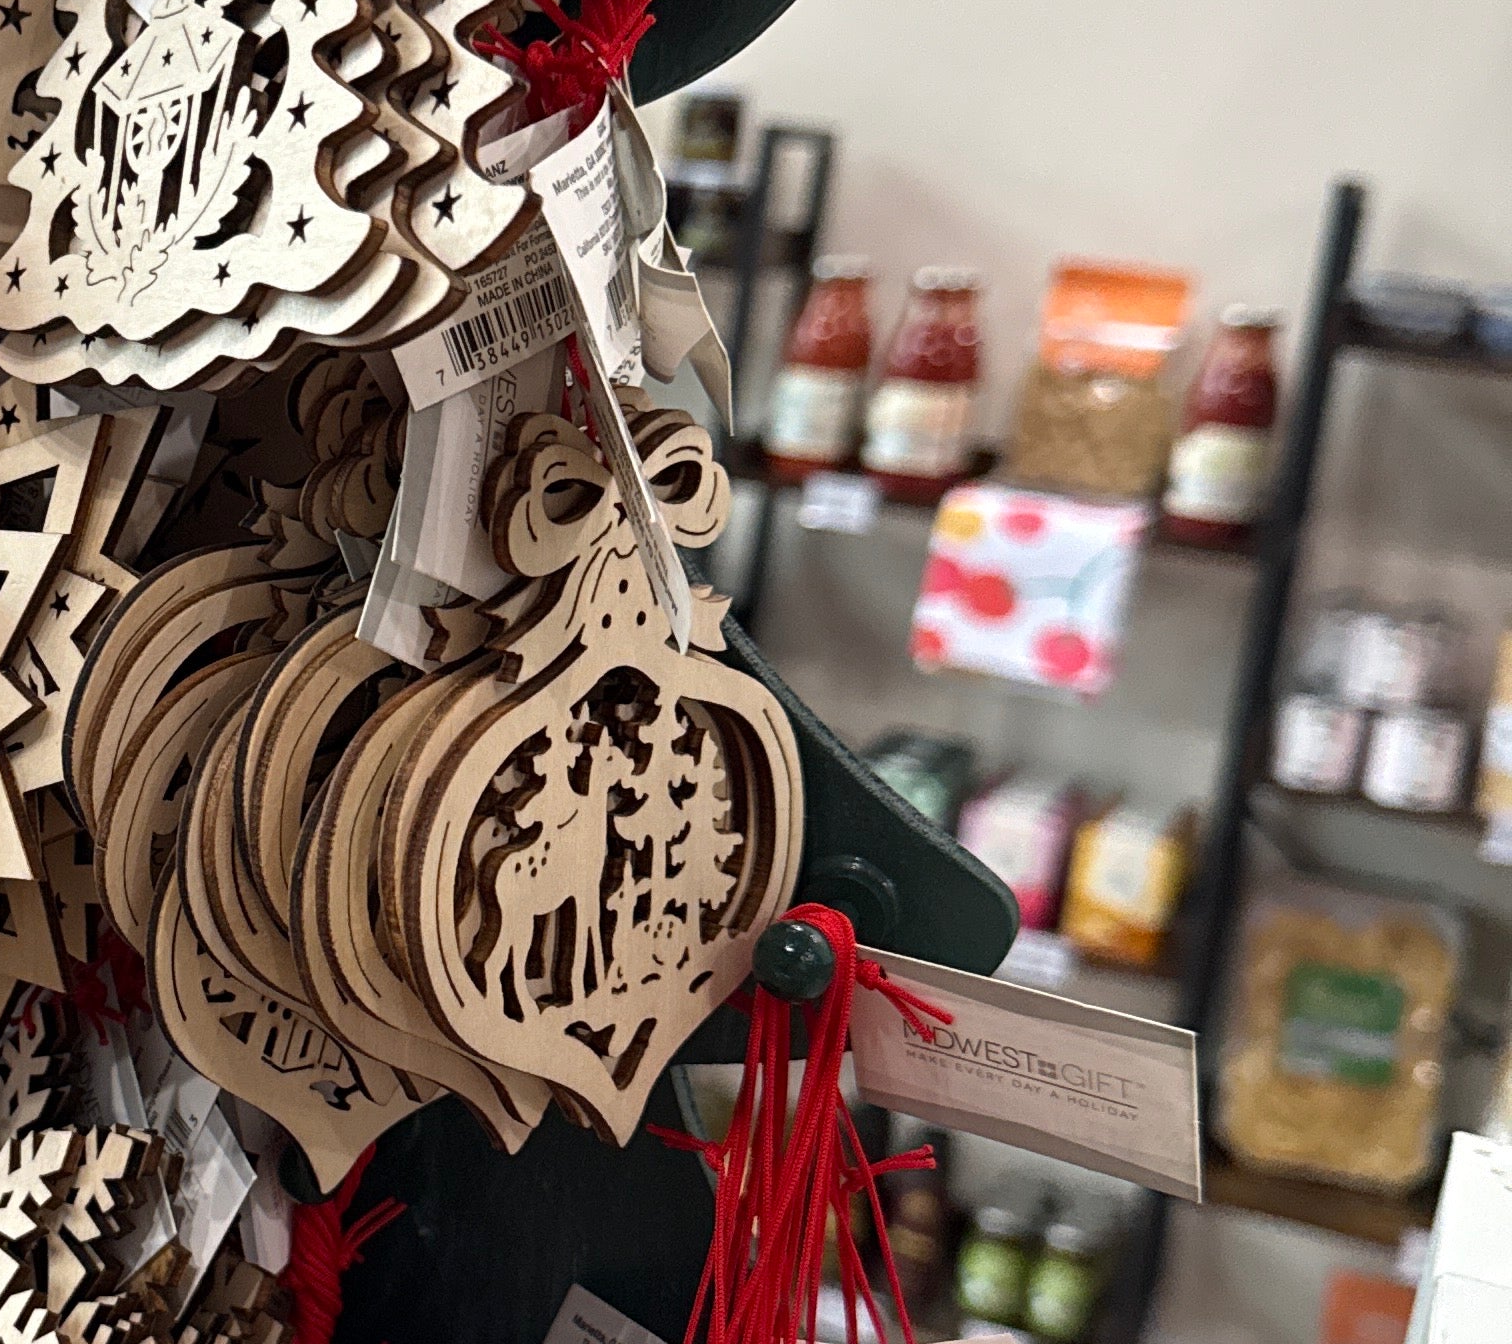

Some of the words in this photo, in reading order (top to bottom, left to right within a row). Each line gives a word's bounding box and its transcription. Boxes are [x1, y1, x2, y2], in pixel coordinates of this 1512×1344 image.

[486, 160, 509, 180] ANZ
[472, 264, 511, 290] 165727
[522, 251, 539, 267] PO
[475, 282, 511, 307] MADE
[510, 276, 525, 291] IN
[521, 261, 555, 285] CHINA
[436, 370, 445, 387] 7
[475, 331, 529, 371] 38449
[477, 394, 487, 430] DAY
[474, 435, 481, 444] A
[463, 451, 481, 525] HOLIDAY
[901, 1019, 1038, 1073] MDWEST
[1061, 1063, 1133, 1099] GIFT
[906, 1049, 947, 1068] MAKE
[954, 1062, 1003, 1083] EVERY
[1012, 1078, 1041, 1093] DAY
[1050, 1090, 1059, 1099] A
[1067, 1095, 1138, 1122] HOLIDAY
